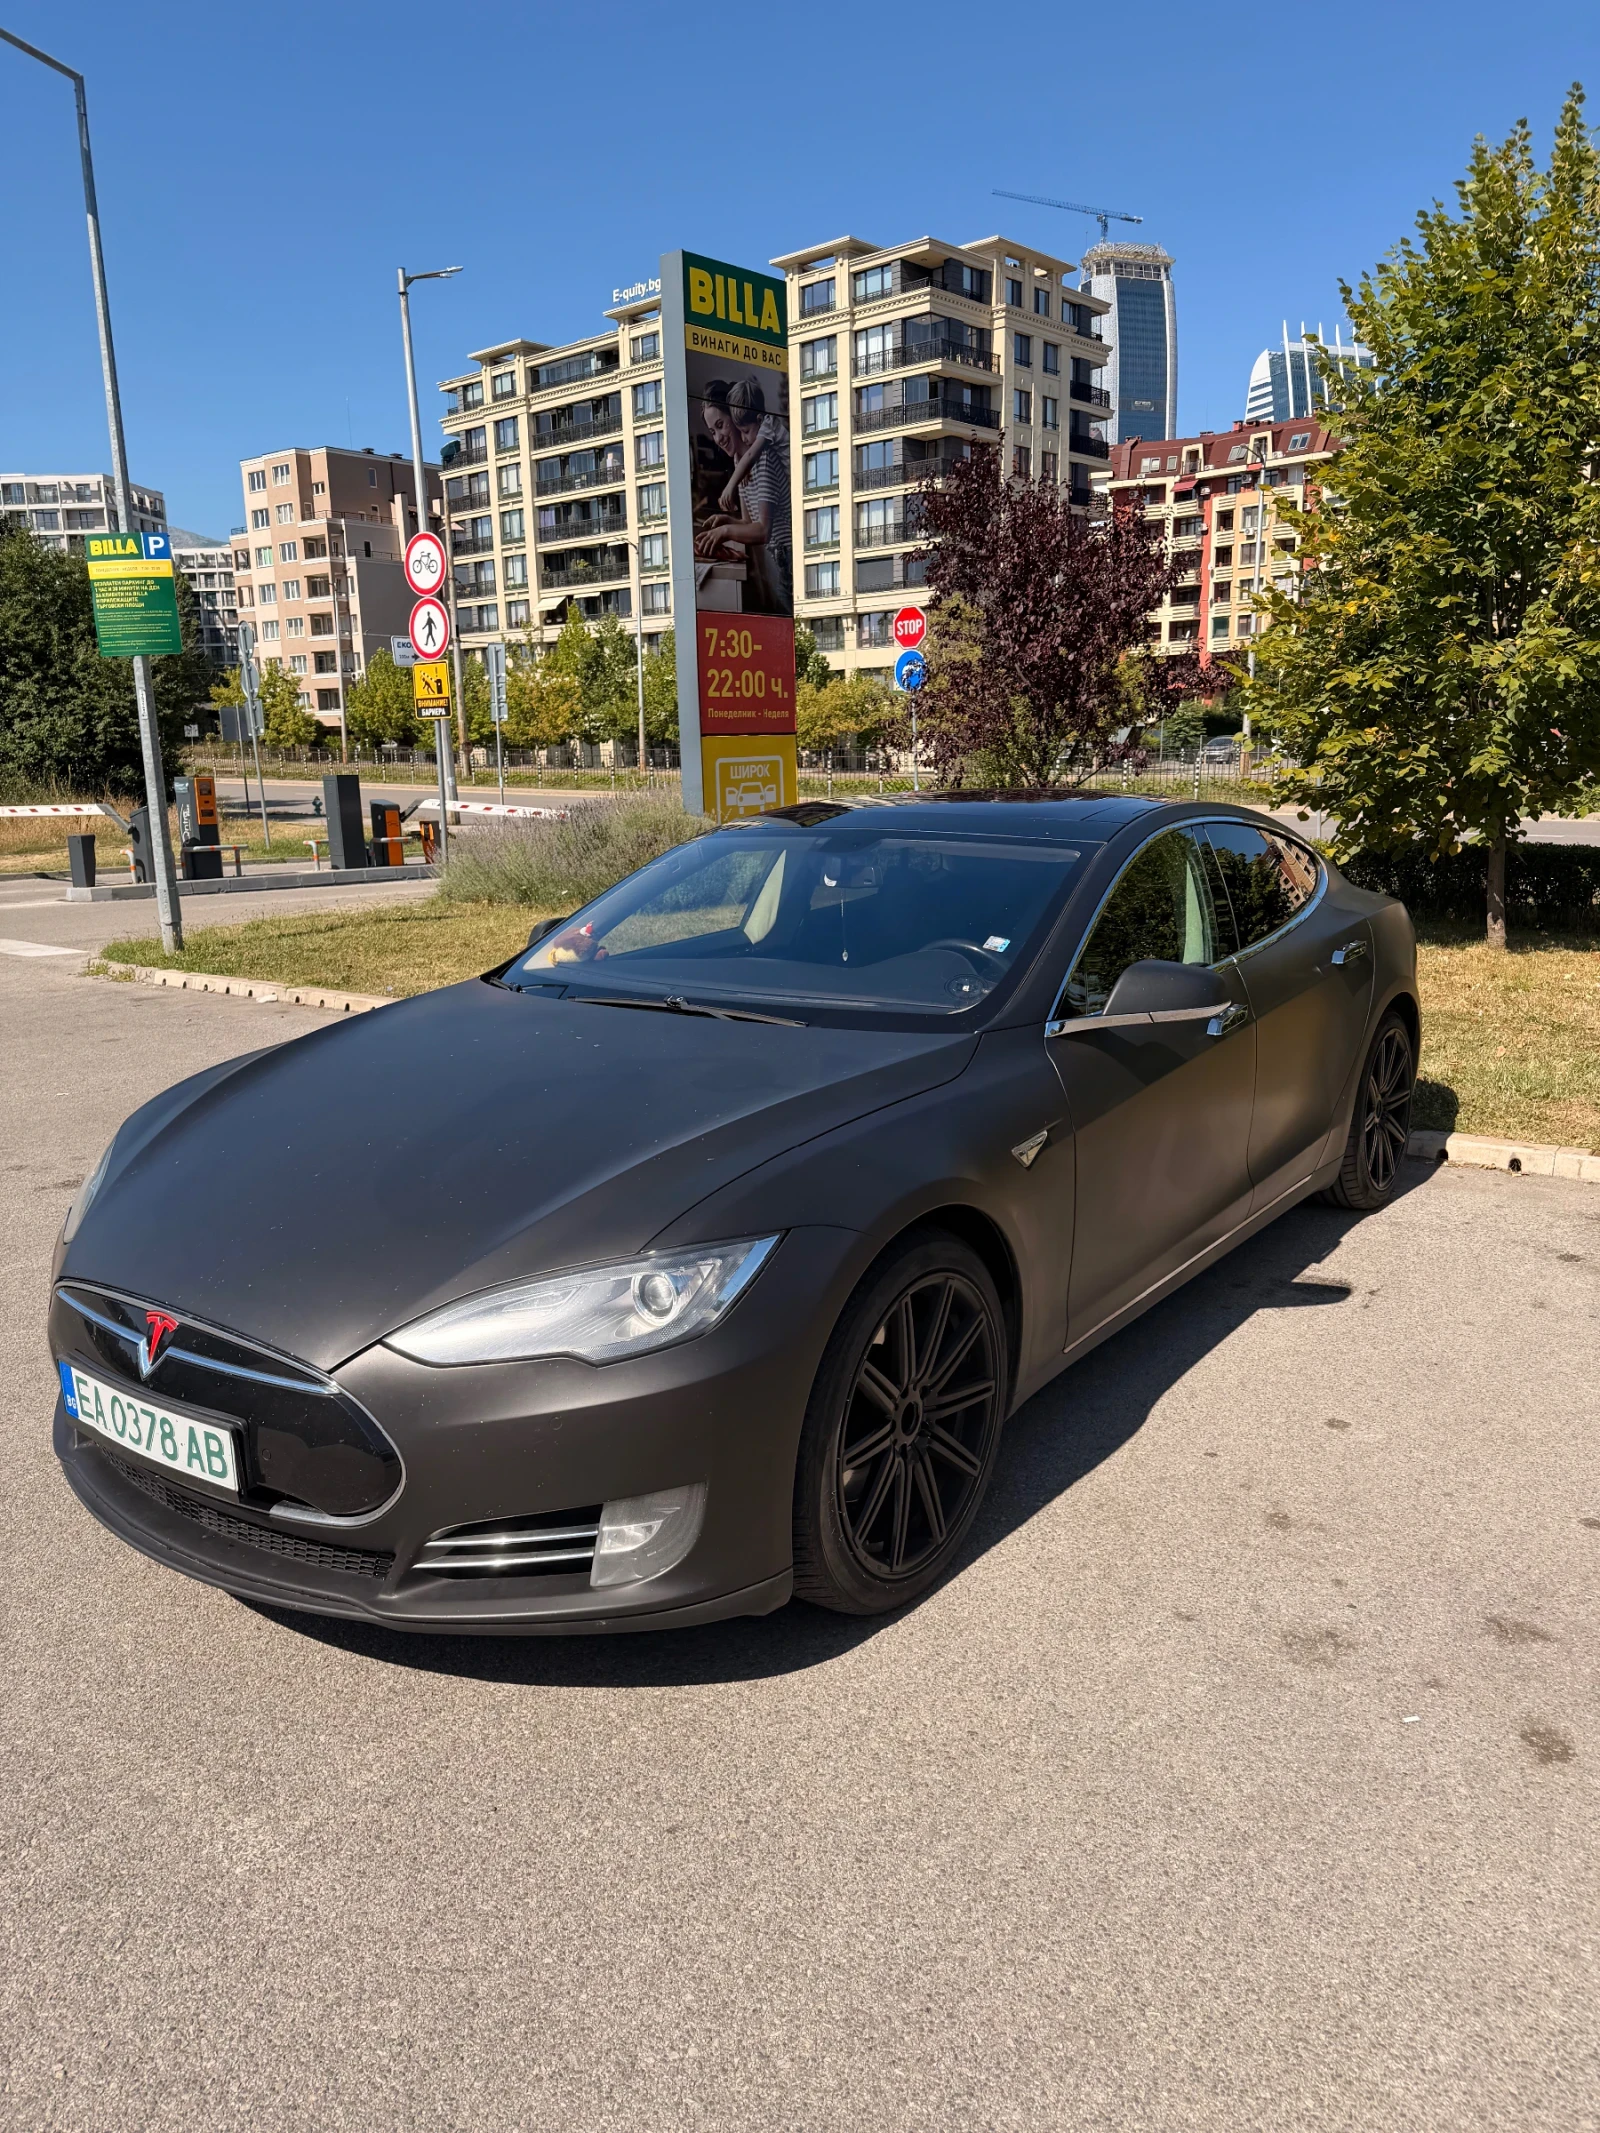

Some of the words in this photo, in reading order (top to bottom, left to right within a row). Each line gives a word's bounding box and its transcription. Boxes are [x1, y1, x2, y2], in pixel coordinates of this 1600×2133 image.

[612, 278, 661, 303] E-quity.bg
[689, 266, 781, 334] BILLA
[692, 332, 739, 356] ВИНАГИ
[743, 345, 758, 361] ДО
[762, 349, 782, 366] ВАС
[89, 538, 139, 556] BILLA
[148, 536, 165, 556] P
[896, 618, 923, 636] STOP
[705, 628, 762, 658] 7:30-
[707, 668, 765, 698] 22:00
[771, 677, 788, 698] ч.
[417, 698, 448, 708] ВНИМАНИЕ!
[421, 707, 446, 716] БАРИЕРА
[708, 708, 756, 720] Понеделник
[763, 708, 789, 719] Неделя
[730, 764, 770, 779] ШИРОК
[66, 1394, 77, 1410] BG
[75, 1375, 108, 1431] EA
[110, 1395, 179, 1462] 0378
[187, 1426, 228, 1479] AB
